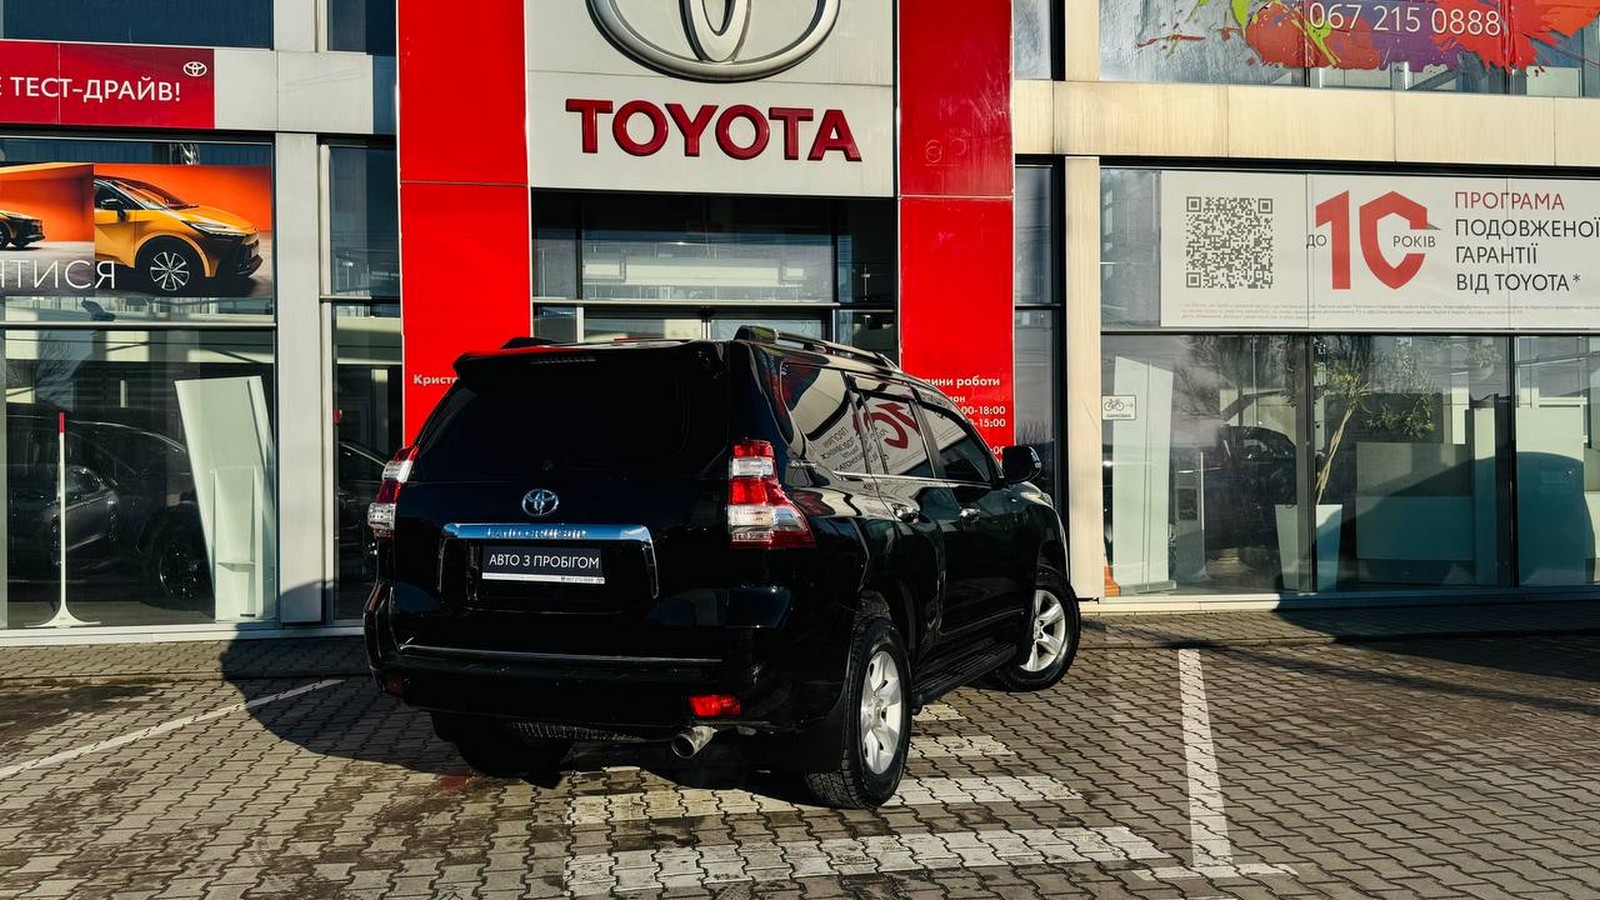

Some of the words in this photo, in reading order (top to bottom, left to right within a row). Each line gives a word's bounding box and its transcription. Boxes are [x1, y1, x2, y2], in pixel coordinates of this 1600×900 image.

[1309, 2, 1363, 30] 067
[1373, 5, 1421, 32] 215
[1431, 8, 1500, 36] 0888
[10, 76, 180, 103] ТЕСТ-ДРАЙВ!
[565, 98, 863, 162] TOYOTA
[1455, 191, 1566, 211] ПРОГРАМА
[1455, 216, 1600, 240] ПОДОВЖЕНОЇ
[1306, 234, 1328, 249] ДО
[1393, 235, 1436, 248] РОКІВ
[1456, 243, 1538, 264] ГАРАНТІЇ
[0, 260, 115, 288] ТИСЯ
[1456, 273, 1490, 294] ВІД
[957, 375, 999, 388] роботи
[489, 554, 520, 566] АВТО
[523, 555, 531, 566] З
[533, 556, 599, 568] ПРОБІГОМ
